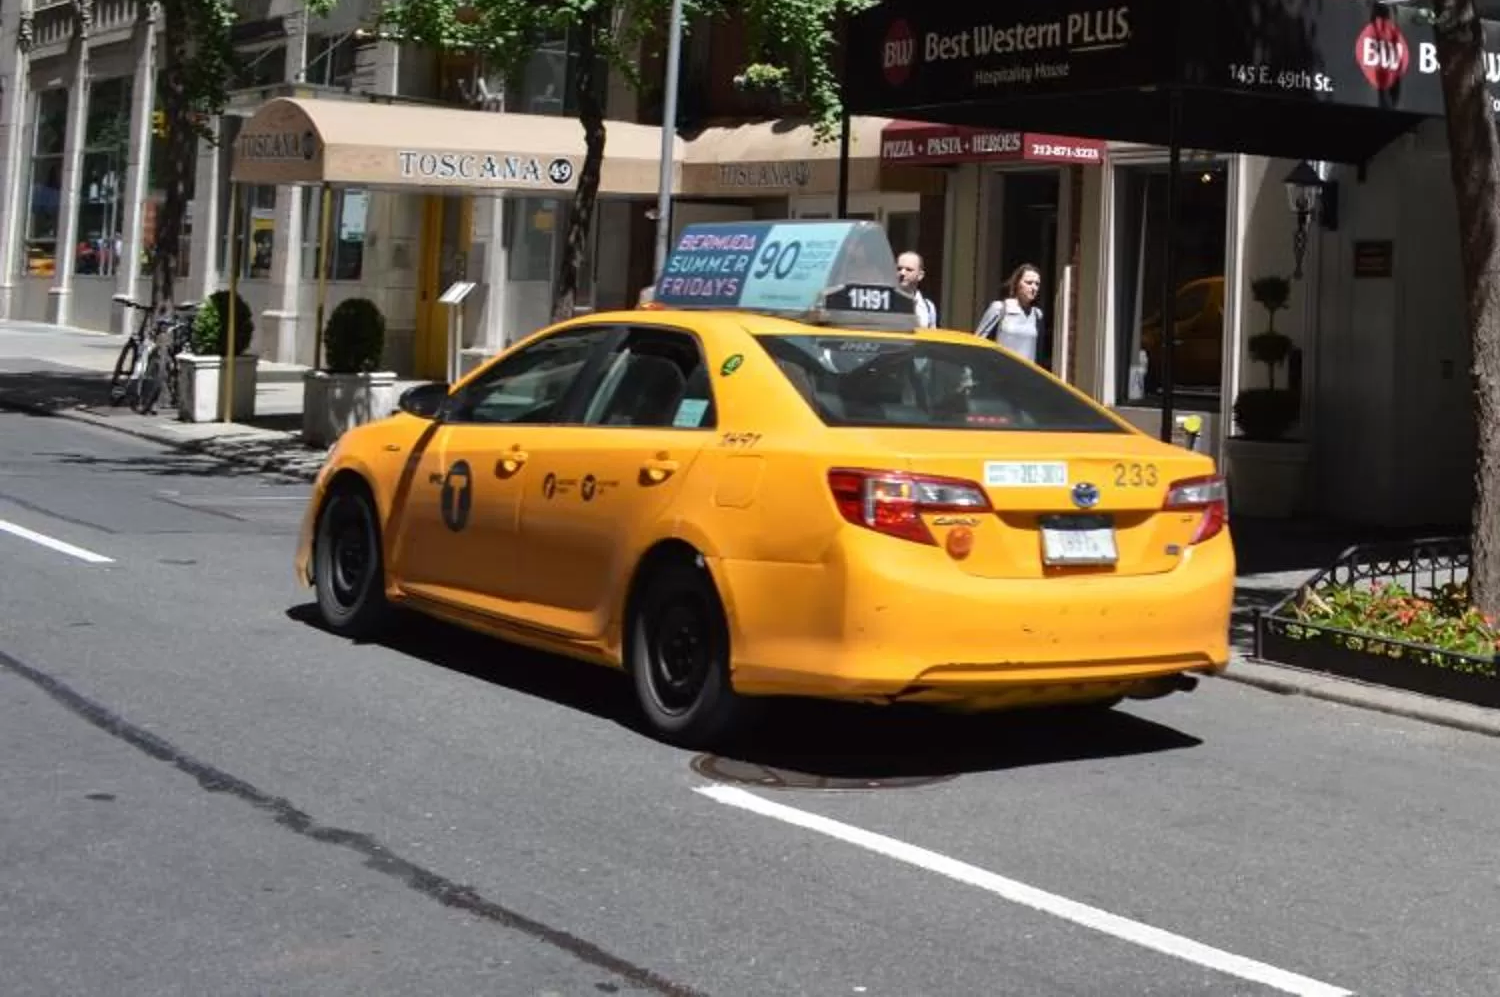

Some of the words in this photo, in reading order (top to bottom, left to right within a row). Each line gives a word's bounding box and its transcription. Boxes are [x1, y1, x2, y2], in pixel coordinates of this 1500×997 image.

[924, 30, 970, 62] Best
[973, 22, 1062, 55] Western
[1067, 6, 1129, 44] PLUS
[884, 39, 914, 68] BW
[1363, 36, 1403, 71] BW
[975, 65, 1033, 87] Hospitality
[1034, 61, 1070, 80] House
[1229, 64, 1255, 84] 145
[1258, 67, 1272, 84] E.
[1277, 70, 1311, 90] 49th
[1313, 73, 1334, 92] St.
[883, 140, 915, 158] PIZZA
[927, 136, 963, 155] PASTA
[972, 132, 1021, 152] HEROES
[399, 152, 541, 181] TOSCANA
[549, 160, 572, 183] 49
[677, 233, 758, 252] BERMUDA
[668, 255, 750, 274] SUMMER
[754, 240, 801, 280] 90
[659, 278, 740, 297] FRIDAYS
[848, 288, 892, 311] 1H91
[1113, 463, 1159, 487] 233
